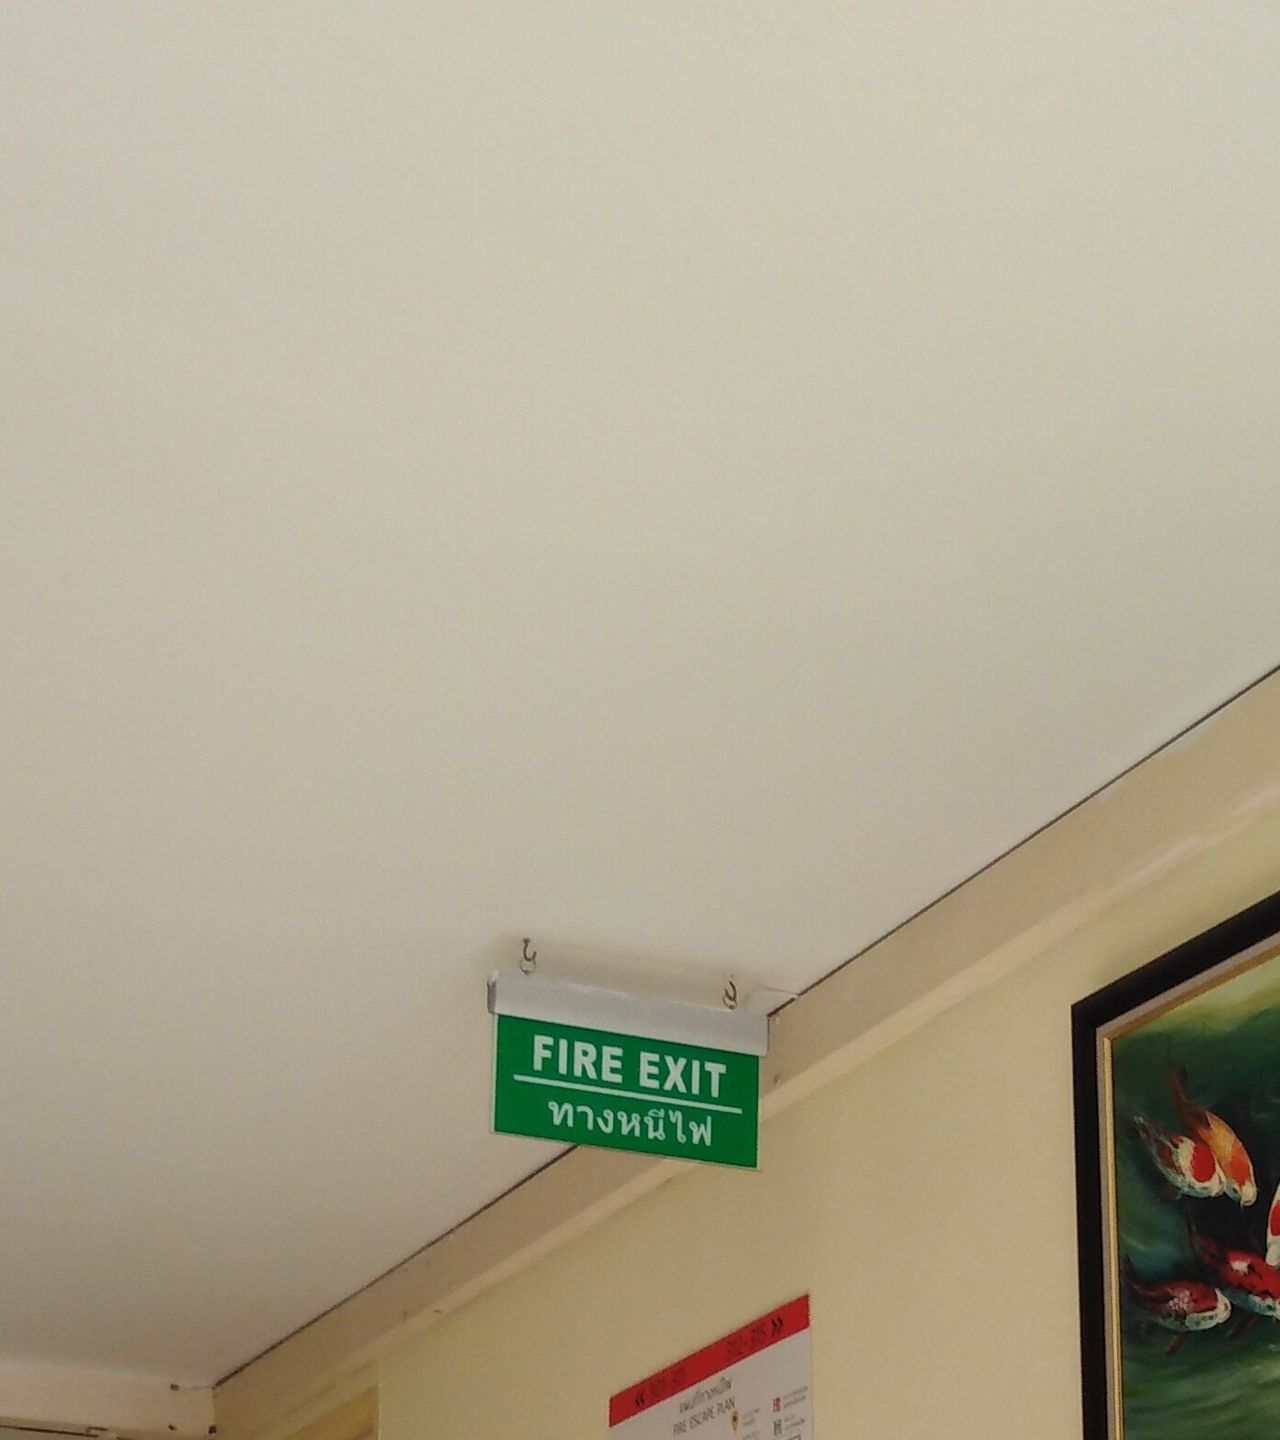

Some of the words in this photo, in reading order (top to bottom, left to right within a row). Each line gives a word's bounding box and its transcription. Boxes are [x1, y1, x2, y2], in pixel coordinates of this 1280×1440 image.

[532, 1034, 623, 1084] FIRE
[639, 1051, 727, 1098] EXIT
[548, 1100, 712, 1147] ทางหนีไฟ
